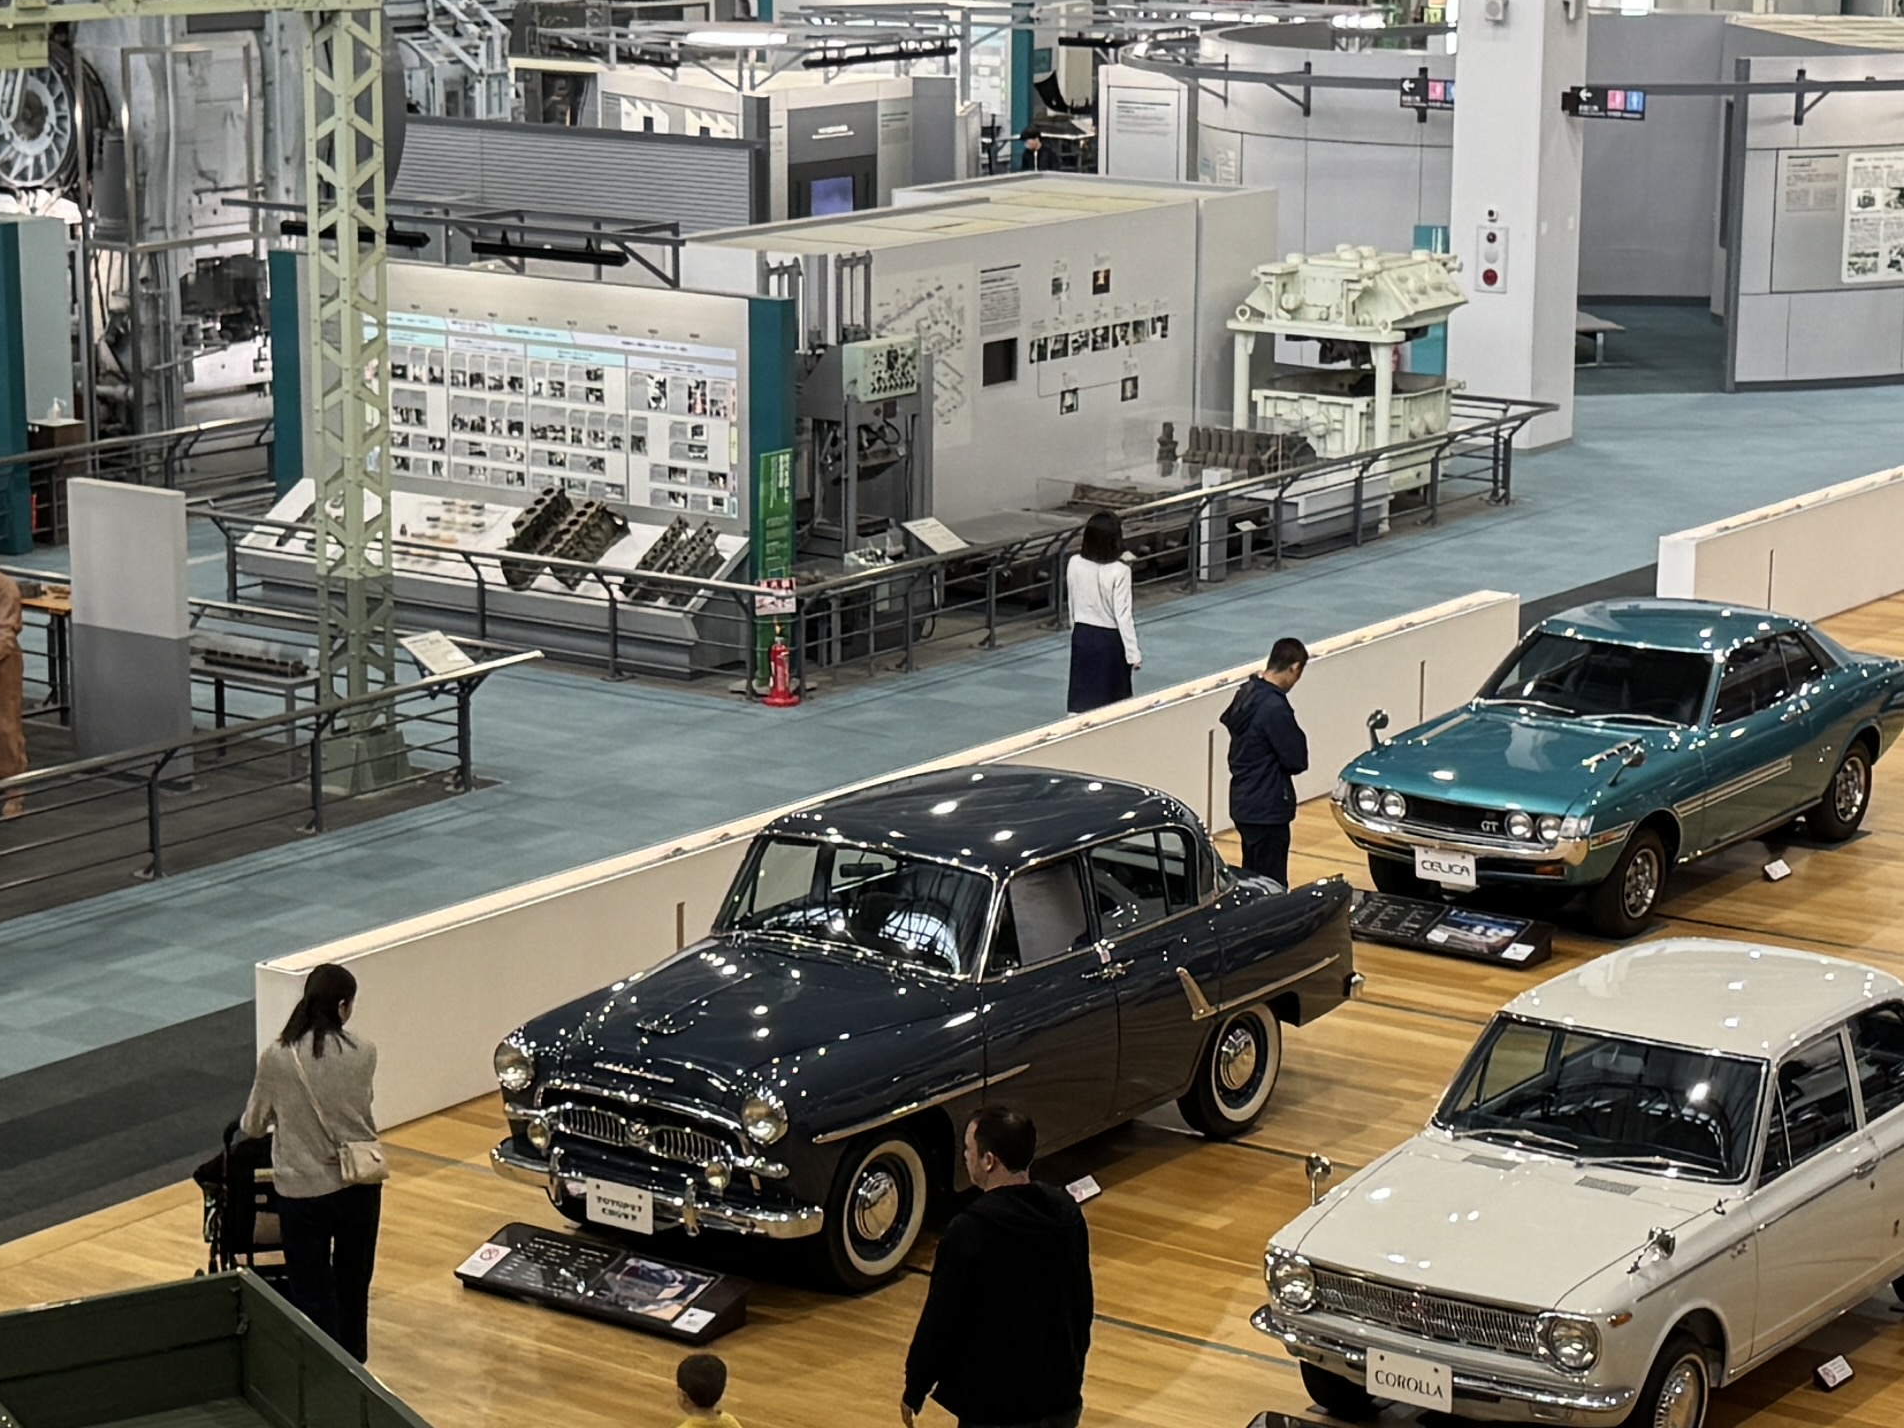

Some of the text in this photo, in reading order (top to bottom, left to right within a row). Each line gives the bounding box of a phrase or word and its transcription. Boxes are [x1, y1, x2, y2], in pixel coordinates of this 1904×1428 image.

[1480, 820, 1499, 833] GT
[1421, 859, 1471, 877] CELICA
[1375, 1370, 1444, 1399] COROLLA
